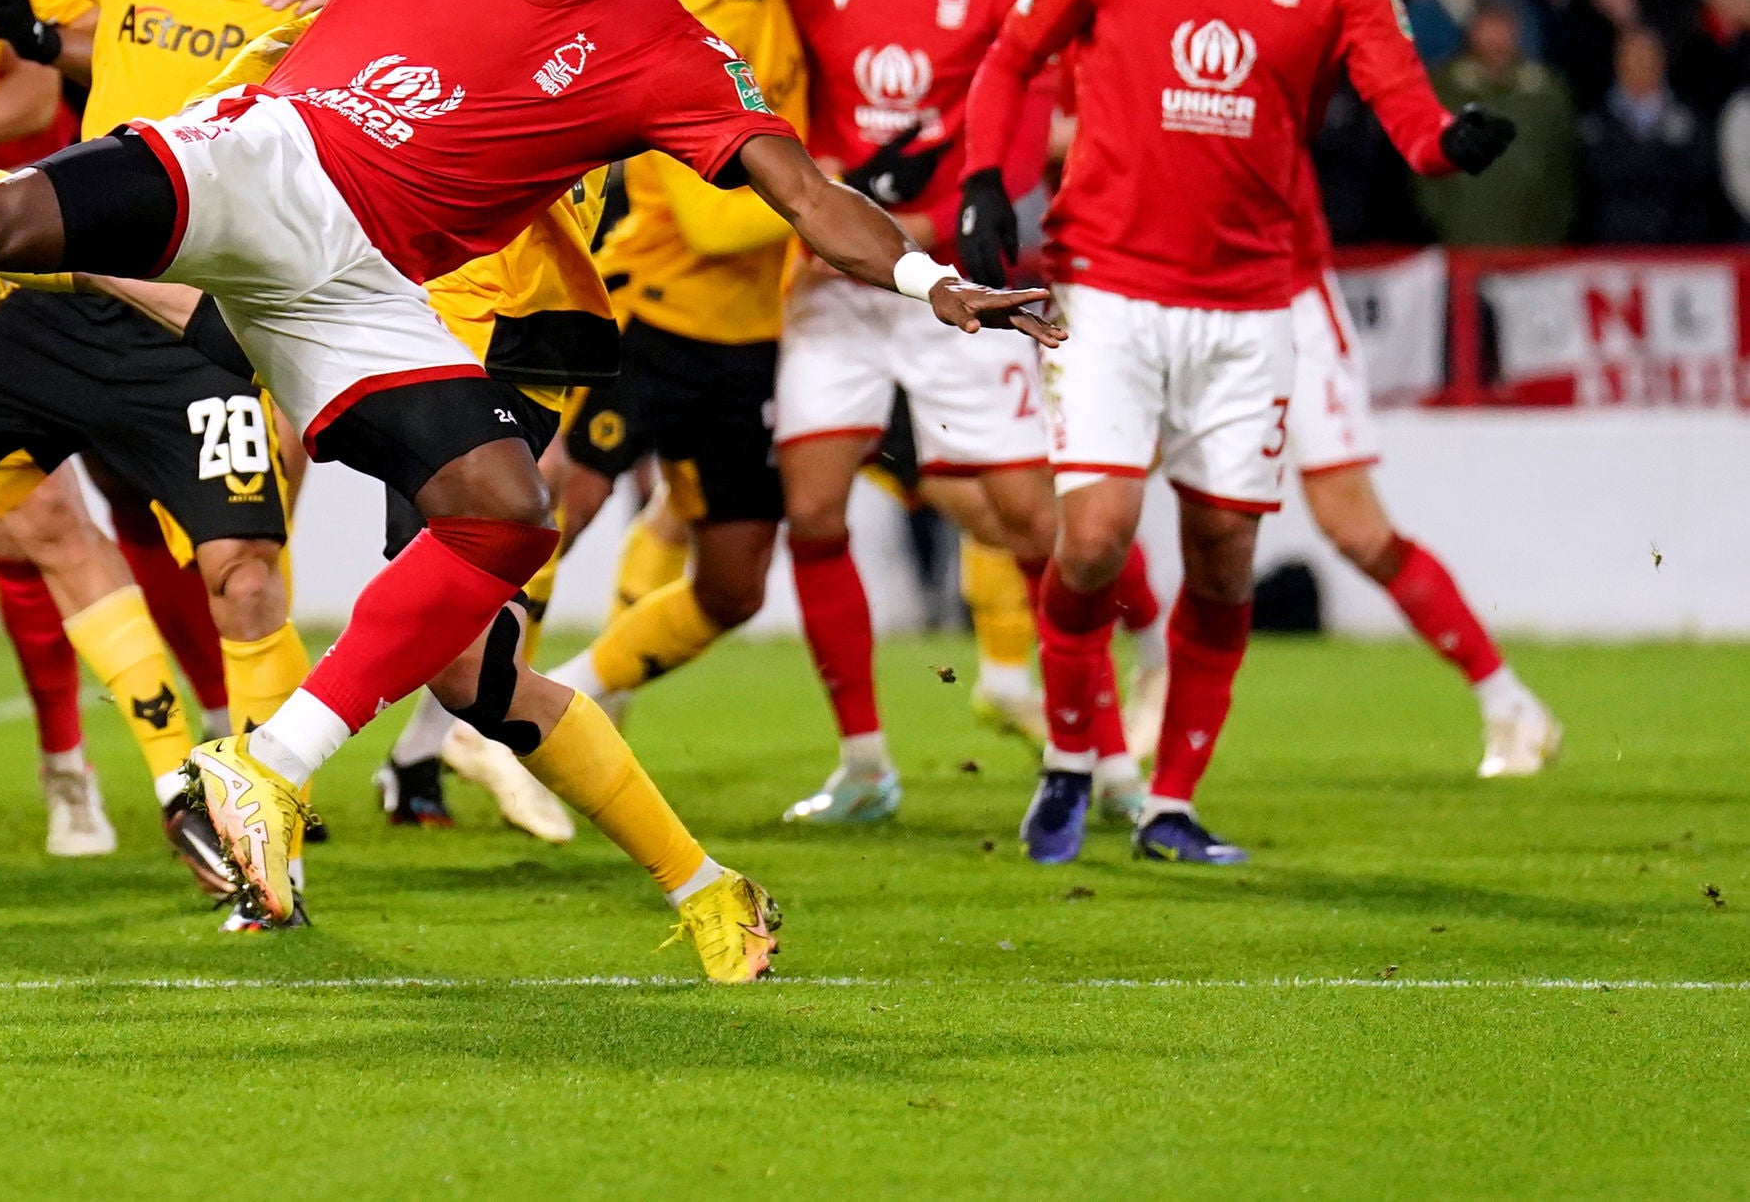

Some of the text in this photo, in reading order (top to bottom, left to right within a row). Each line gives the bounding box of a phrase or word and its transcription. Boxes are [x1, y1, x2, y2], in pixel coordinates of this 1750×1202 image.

[117, 3, 254, 62] AstroP
[532, 69, 563, 97] FOREST
[1161, 88, 1256, 119] UNHCR
[187, 395, 270, 480] 28
[1261, 396, 1290, 459] 3
